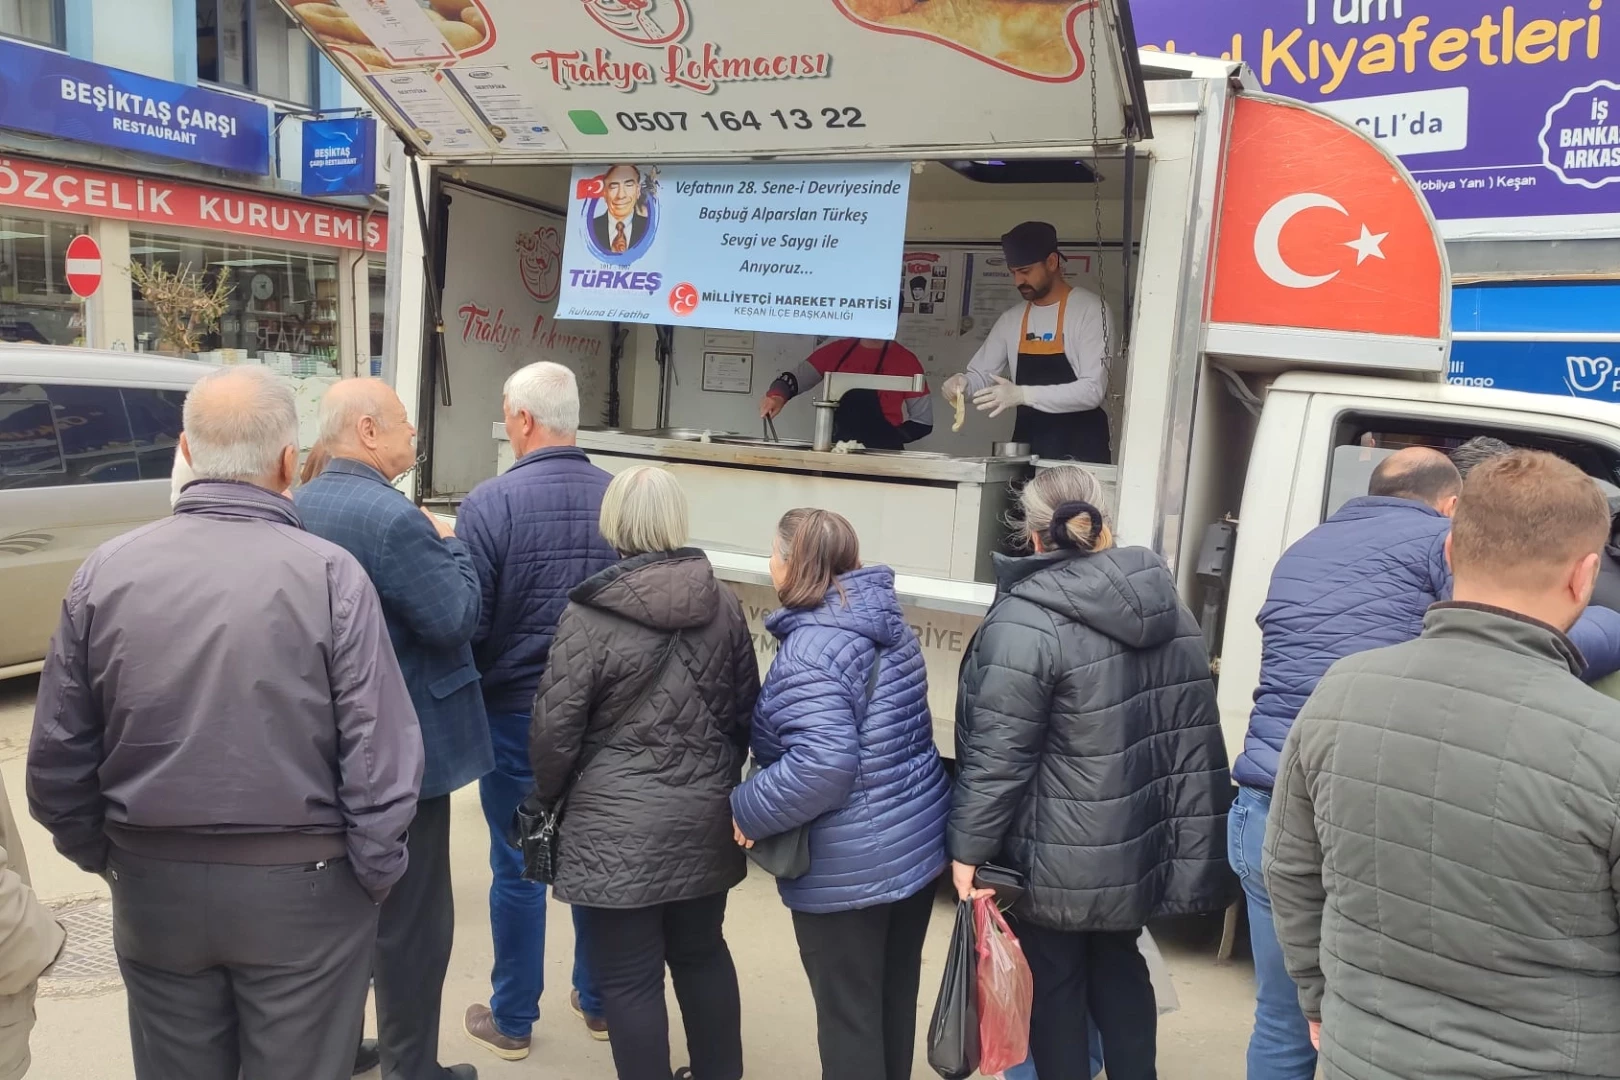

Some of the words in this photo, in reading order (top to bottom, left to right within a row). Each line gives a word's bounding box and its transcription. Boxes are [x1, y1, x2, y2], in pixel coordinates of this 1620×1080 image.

[1261, 0, 1602, 94] Kıyafetleri
[530, 47, 650, 91] Trakya
[660, 42, 826, 92] Lokmacısı
[61, 78, 172, 125] BEŞİKTAŞ
[177, 106, 237, 138] ÇARŞI
[1590, 97, 1609, 125] İŞ
[616, 110, 688, 132] 0507
[701, 110, 762, 132] 164
[770, 108, 813, 130] 13
[820, 106, 866, 129] 22
[113, 117, 198, 145] RESTAURANT
[1560, 126, 1620, 147] BANKA
[314, 146, 351, 159] BEŞİKTAŞ
[676, 180, 734, 197] Vefatının
[737, 181, 757, 195] 28.
[761, 180, 805, 195] Sene-i
[807, 179, 901, 198] Devriyesinde
[1460, 178, 1485, 189] Yanı
[1497, 175, 1536, 191] Keşan
[0, 160, 174, 216] ÖZÇELİK
[200, 195, 380, 247] KURUYEMİŞ
[698, 206, 748, 223] Başbuğ
[751, 207, 817, 223] Alparslan
[823, 207, 868, 225] Türkeş
[720, 233, 757, 248] Sevgi
[760, 236, 777, 247] ve
[779, 234, 818, 251] Saygı
[821, 234, 839, 249] ile
[738, 259, 813, 276] Anıyoruz...
[701, 289, 772, 305] MİLLİYETÇİ
[775, 294, 836, 308] HAREKET
[839, 296, 892, 310] PARTİSİ
[568, 306, 605, 317] Ruhuna
[607, 309, 618, 318] El
[618, 309, 650, 319] Fatiha
[734, 306, 766, 317] KEŞAN
[769, 306, 790, 318] İLÇE
[793, 309, 854, 321] BAŞKANLIĞI
